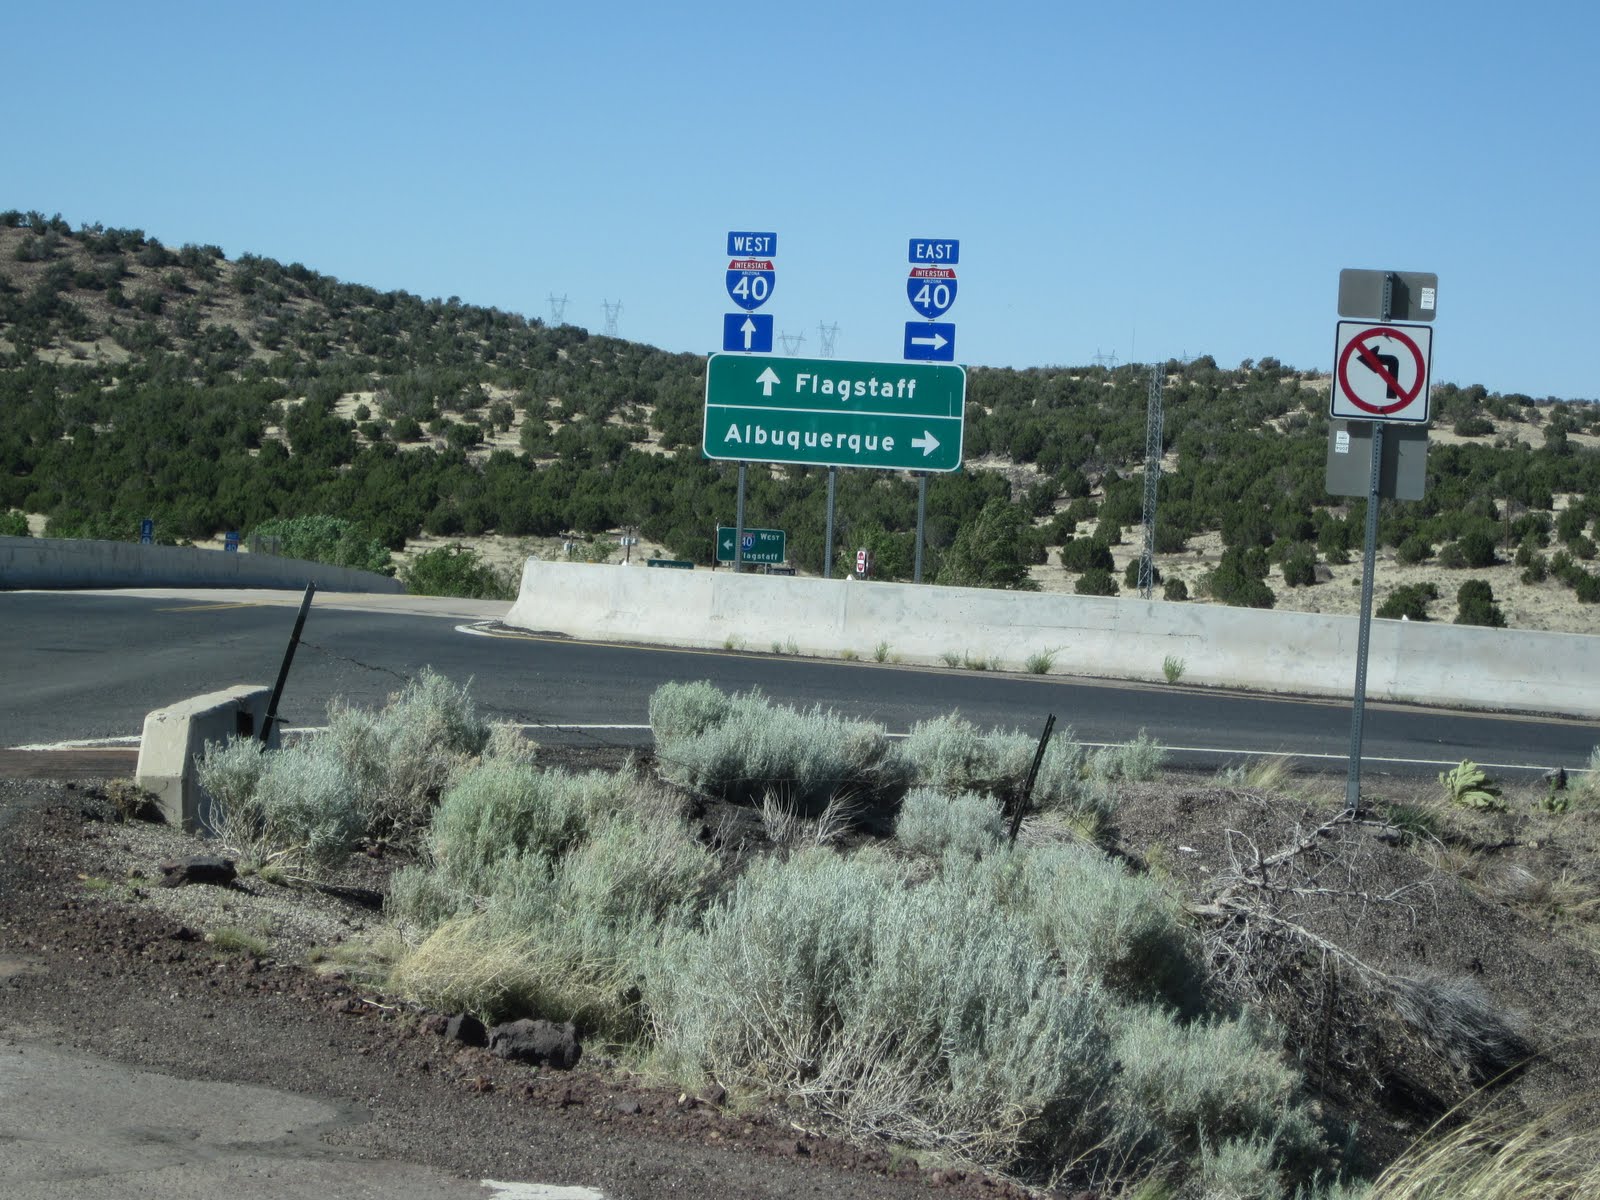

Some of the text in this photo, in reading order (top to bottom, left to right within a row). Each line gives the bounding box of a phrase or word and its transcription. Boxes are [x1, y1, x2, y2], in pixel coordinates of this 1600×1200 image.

[733, 236, 771, 252] WEST
[916, 243, 953, 259] EAST
[734, 262, 768, 270] INTERSTATE
[915, 270, 950, 278] INTERSTATE
[732, 276, 768, 301] 40
[913, 284, 950, 309] 40
[795, 373, 917, 402] Flagstaff
[723, 423, 895, 454] Albuquerque
[760, 532, 780, 541] WEST
[741, 551, 778, 561] lagstaff
